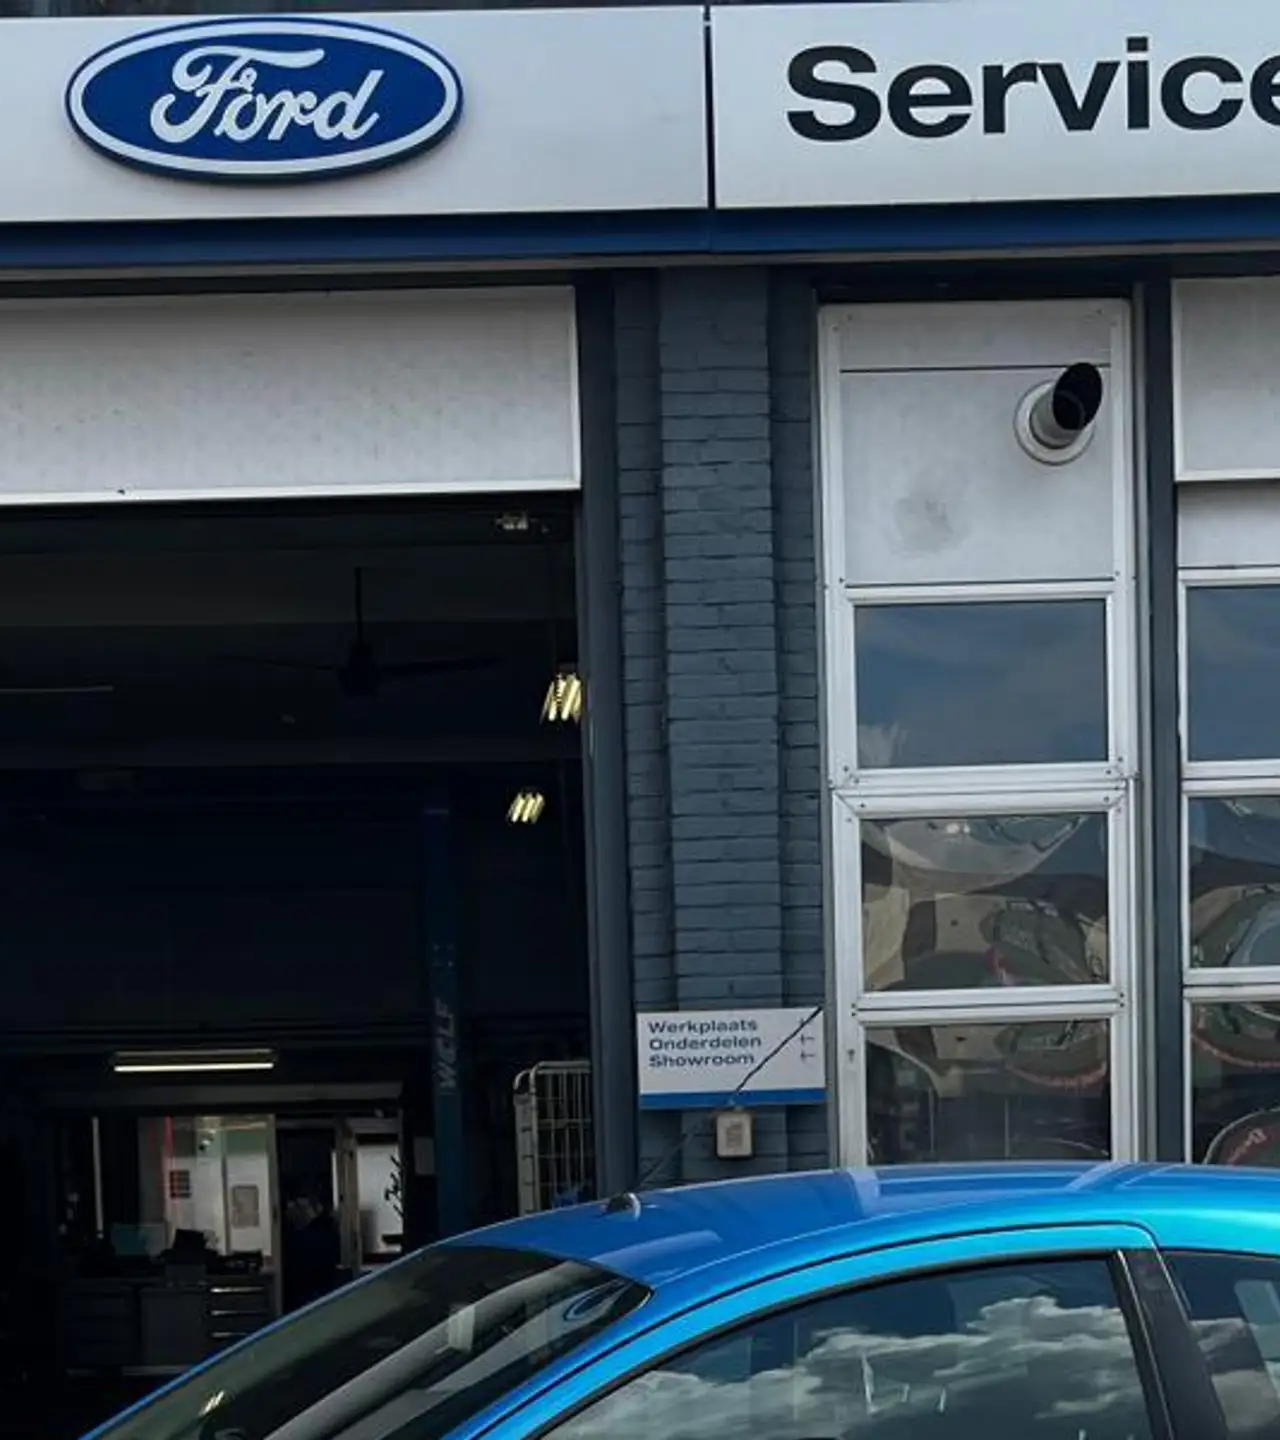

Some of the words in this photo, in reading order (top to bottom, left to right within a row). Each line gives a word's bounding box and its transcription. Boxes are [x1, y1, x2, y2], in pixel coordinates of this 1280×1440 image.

[149, 45, 384, 144] Ford
[647, 1018, 759, 1036] Werkplaats
[648, 1035, 762, 1052] Onderdelen
[648, 1052, 756, 1069] Showroom
